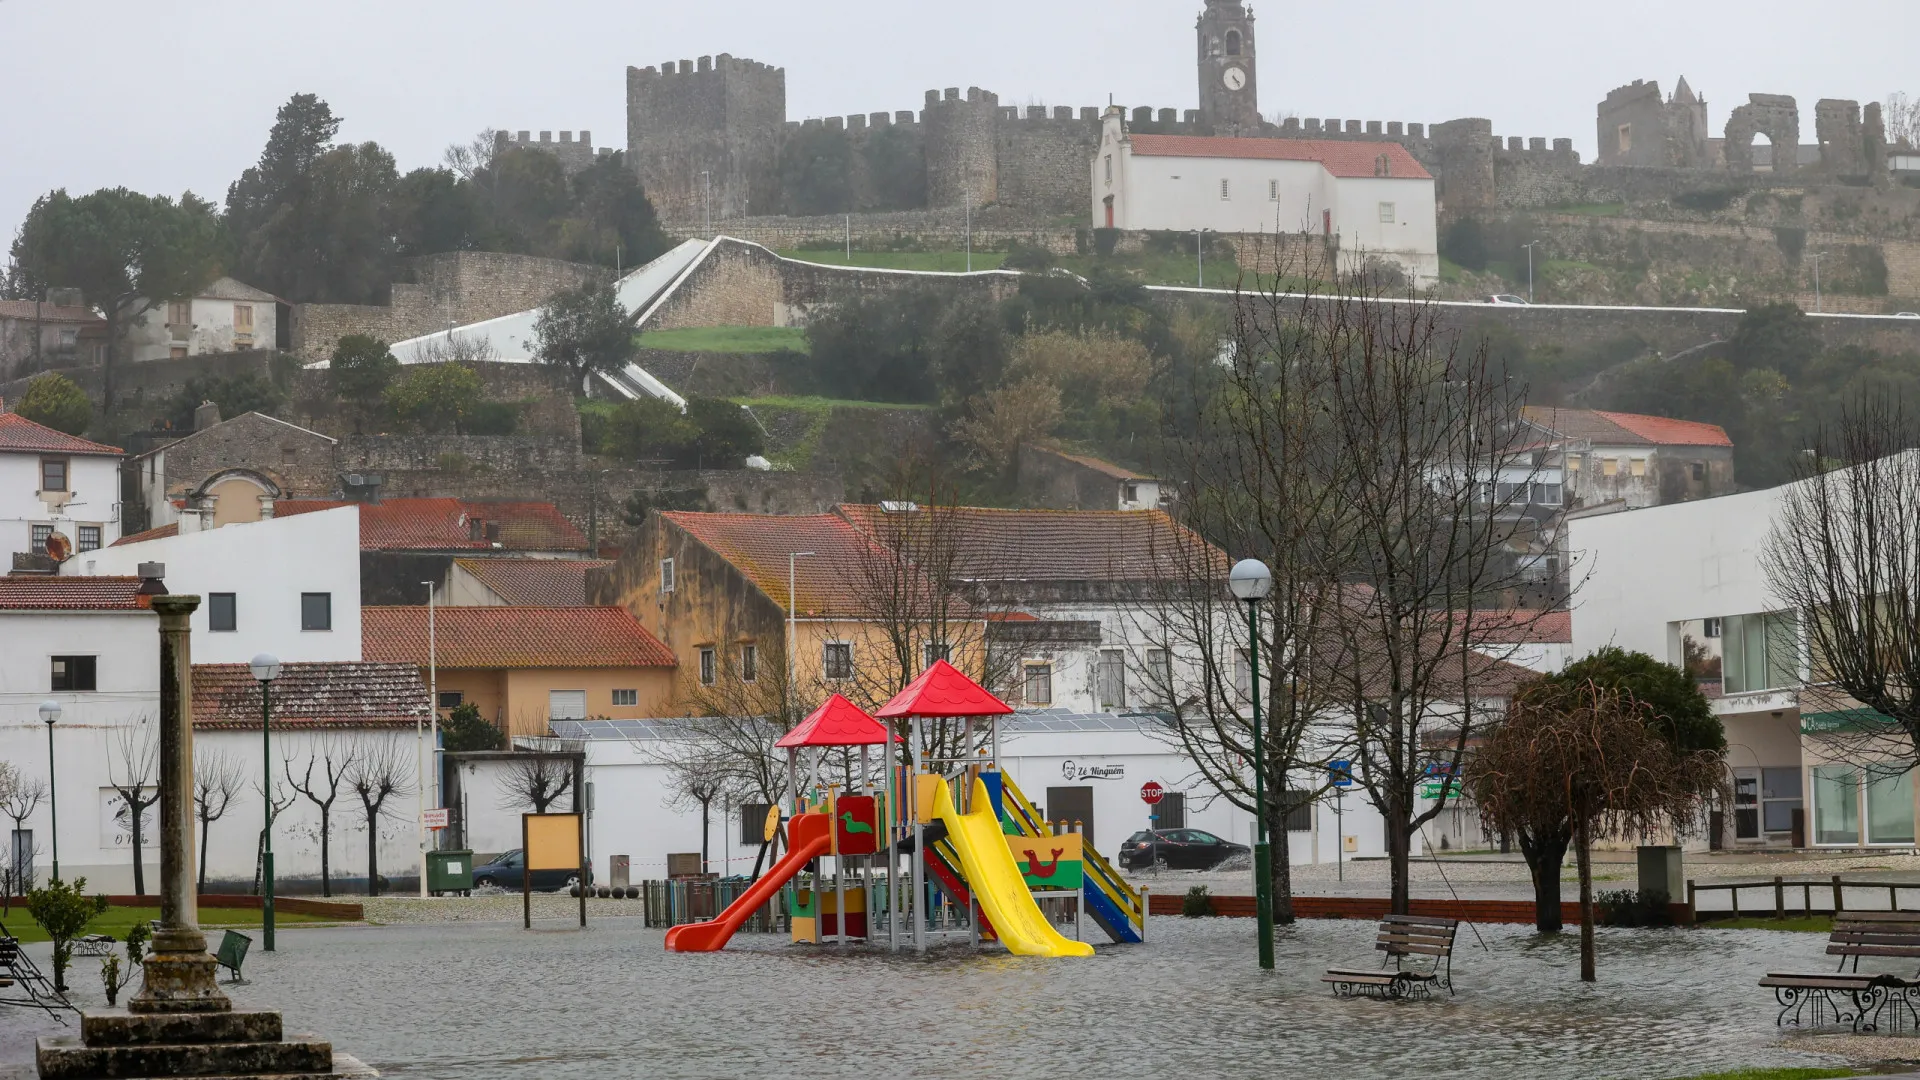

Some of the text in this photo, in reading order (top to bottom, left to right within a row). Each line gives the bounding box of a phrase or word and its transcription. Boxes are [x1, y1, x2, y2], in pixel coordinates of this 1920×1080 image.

[1078, 766, 1124, 777] Zé Ninguém
[1141, 789, 1162, 798] STOP
[115, 834, 123, 845] O
